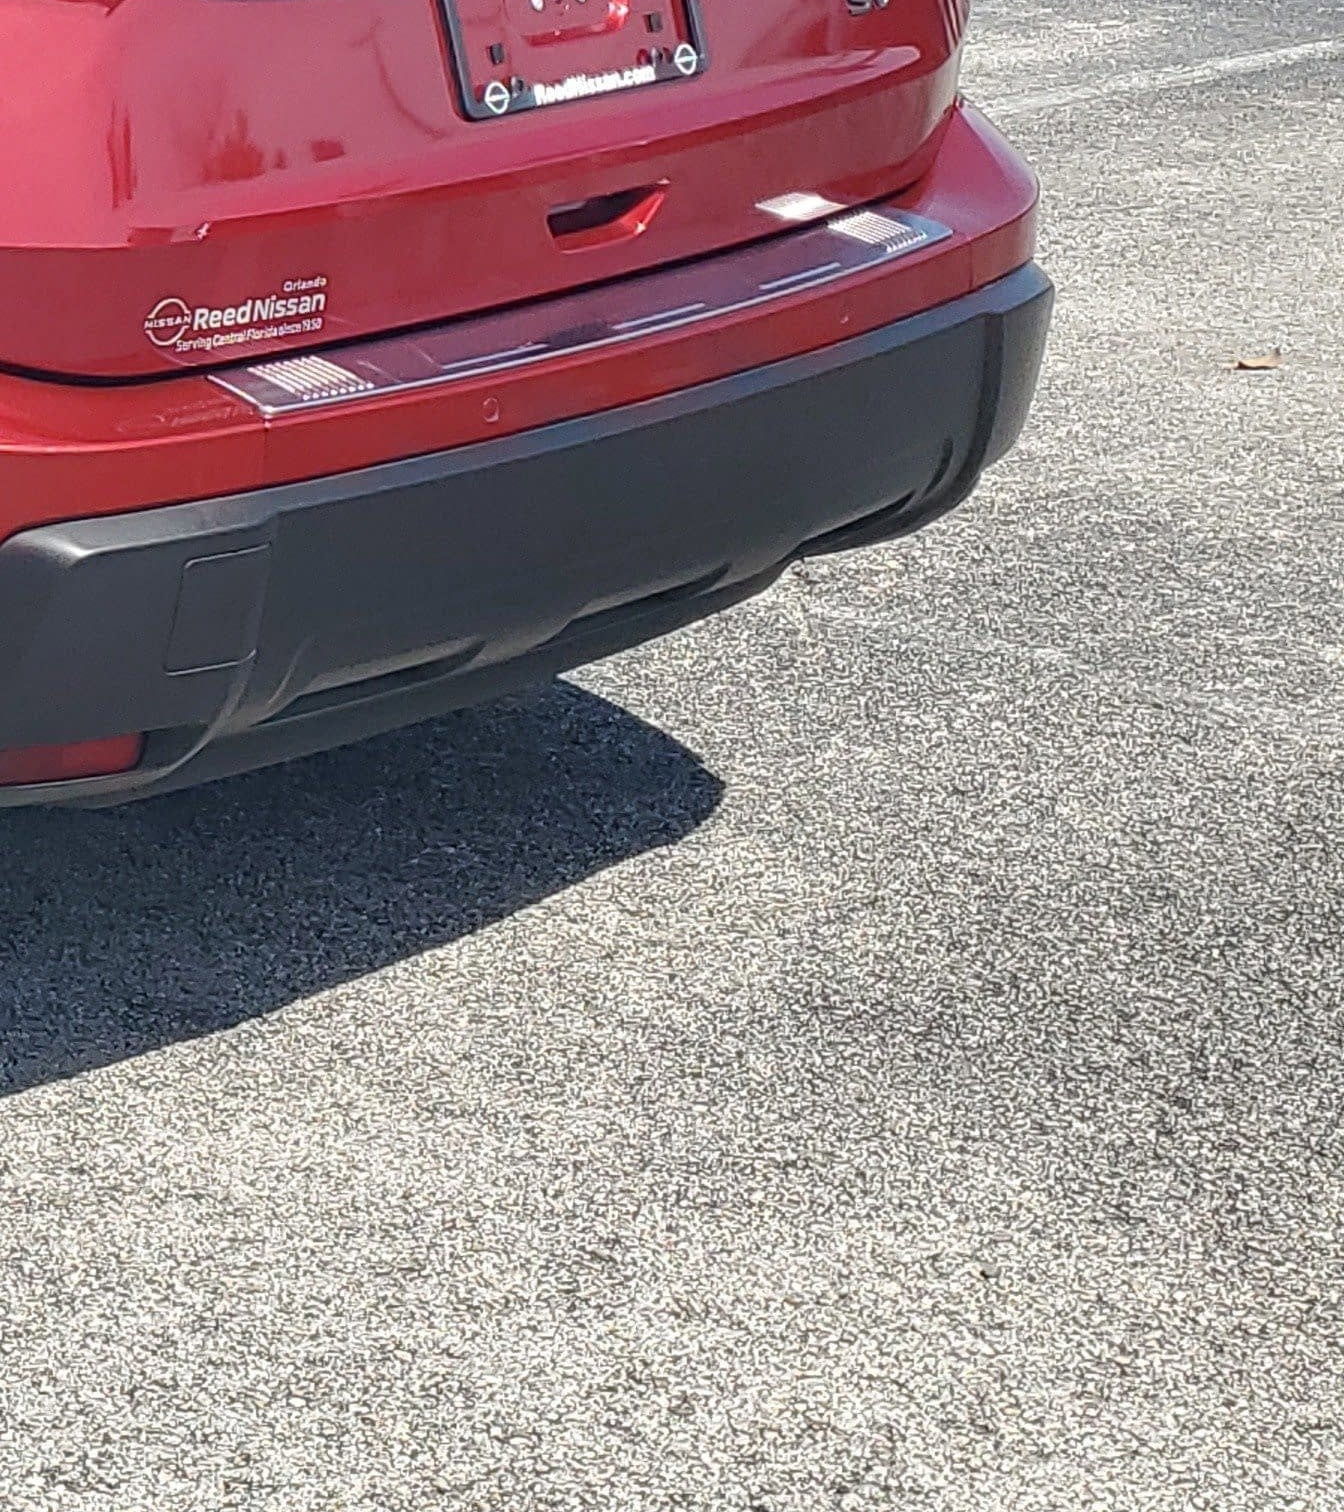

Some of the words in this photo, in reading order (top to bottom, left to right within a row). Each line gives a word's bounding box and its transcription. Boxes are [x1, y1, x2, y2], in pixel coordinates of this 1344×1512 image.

[283, 276, 327, 292] Orlando
[144, 313, 192, 329] NISSAN
[175, 337, 212, 352] Serving
[212, 330, 246, 347] Central
[246, 326, 278, 340] Florida
